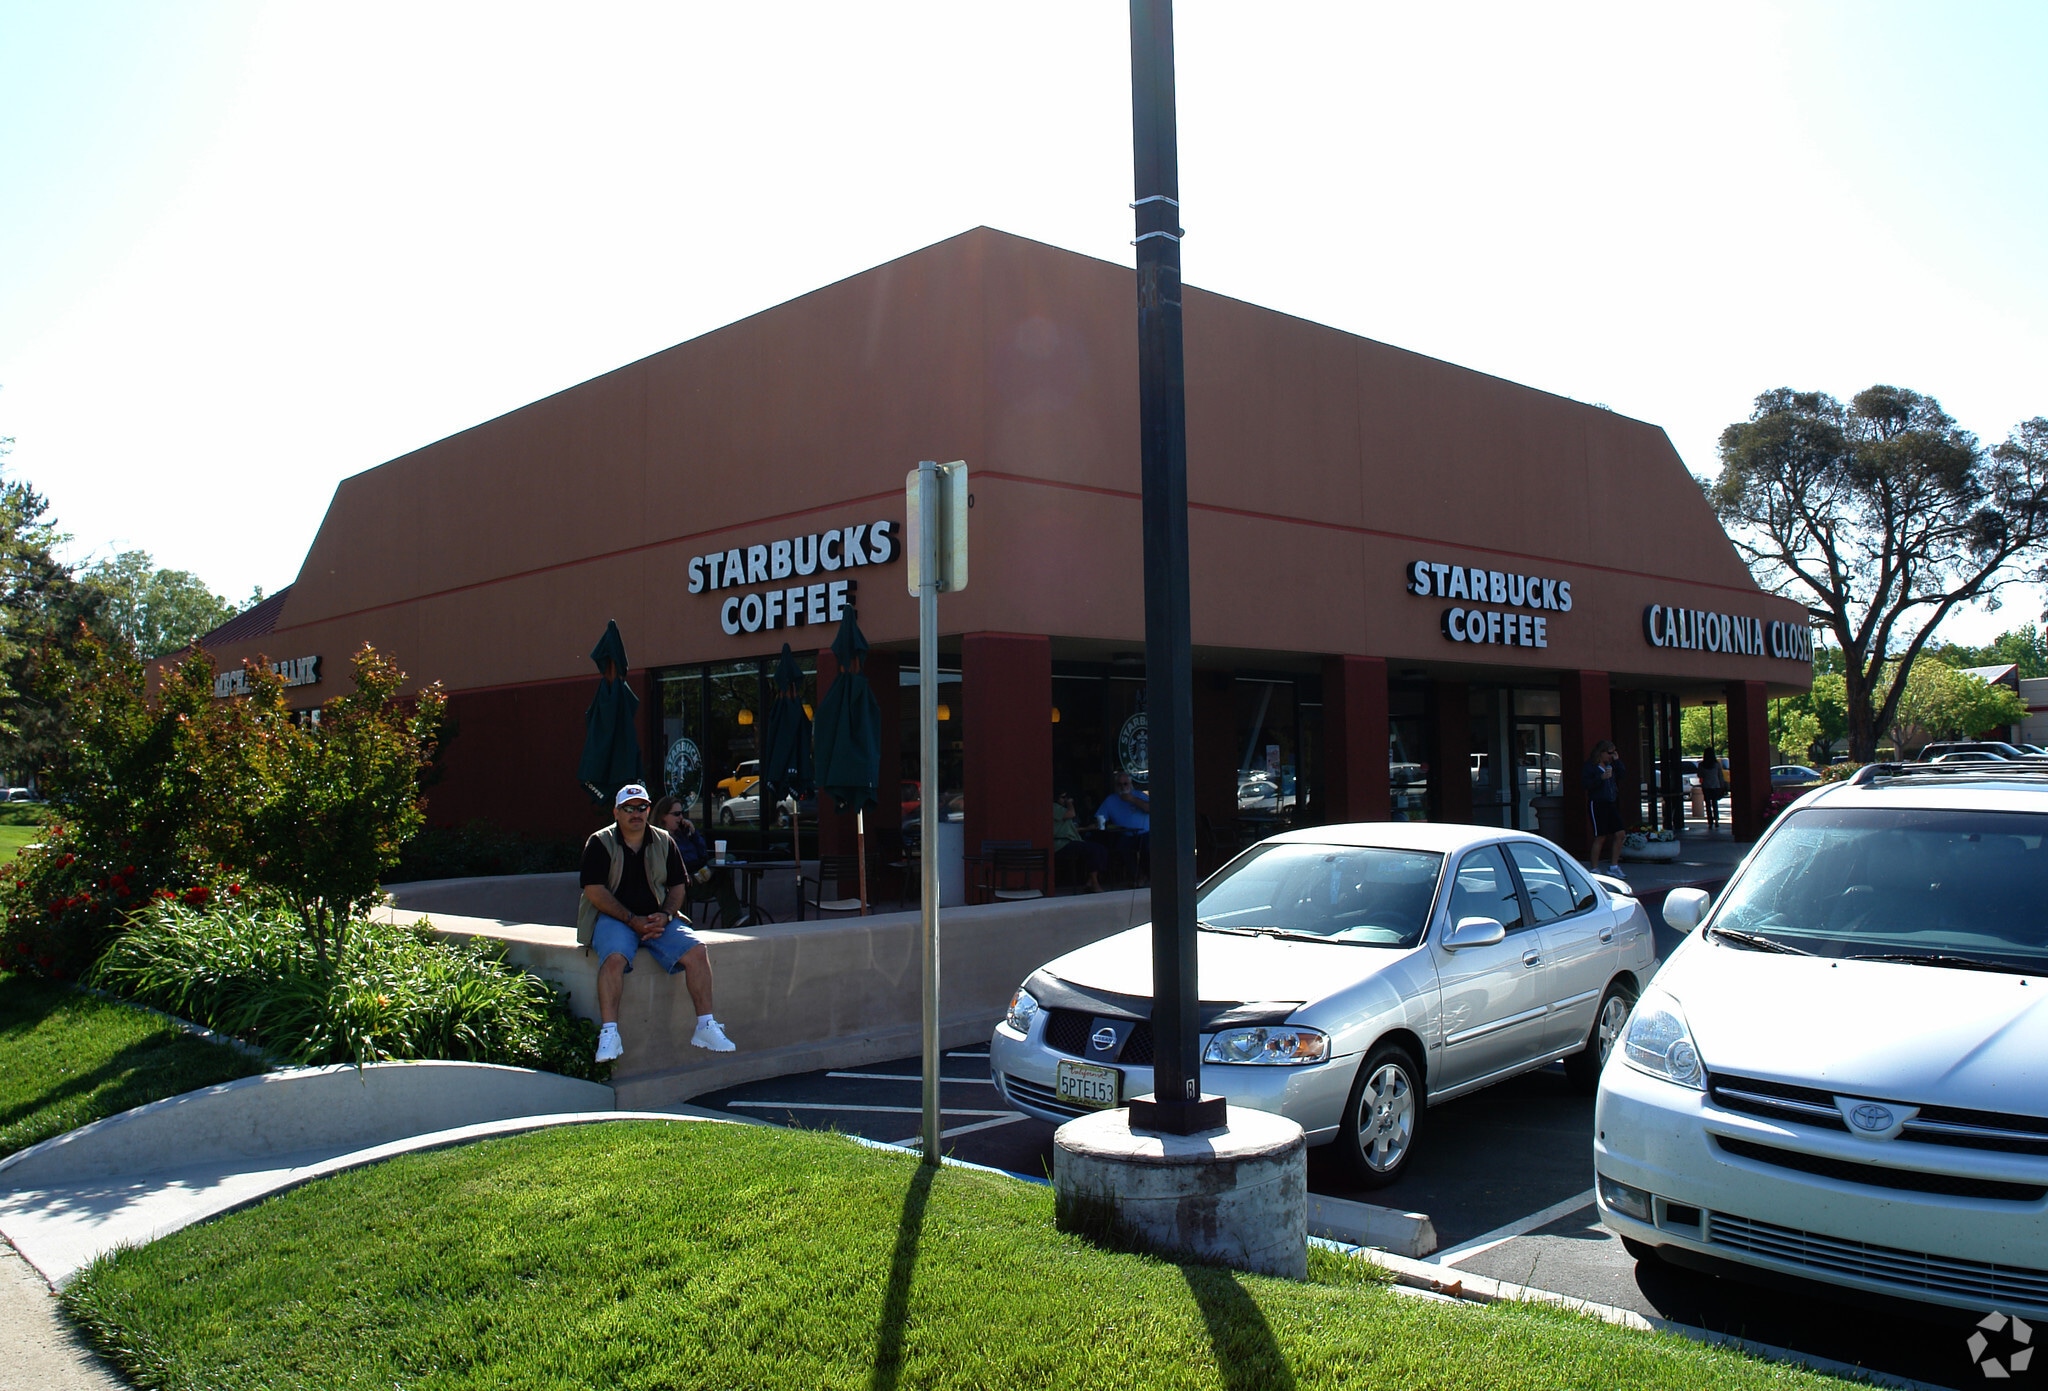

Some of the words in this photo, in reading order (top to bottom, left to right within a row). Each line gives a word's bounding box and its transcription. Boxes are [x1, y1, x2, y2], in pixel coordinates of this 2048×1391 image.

[688, 520, 893, 595] STARBUCKS
[720, 579, 850, 636] COFFEE
[1413, 560, 1574, 613] STARBUCKS
[1447, 607, 1548, 648] COFFEE
[1649, 603, 1766, 656] CALIFORNIA
[280, 655, 318, 688] BANK
[1121, 716, 1148, 745] STARB
[1061, 1075, 1115, 1103] 5PTE153
